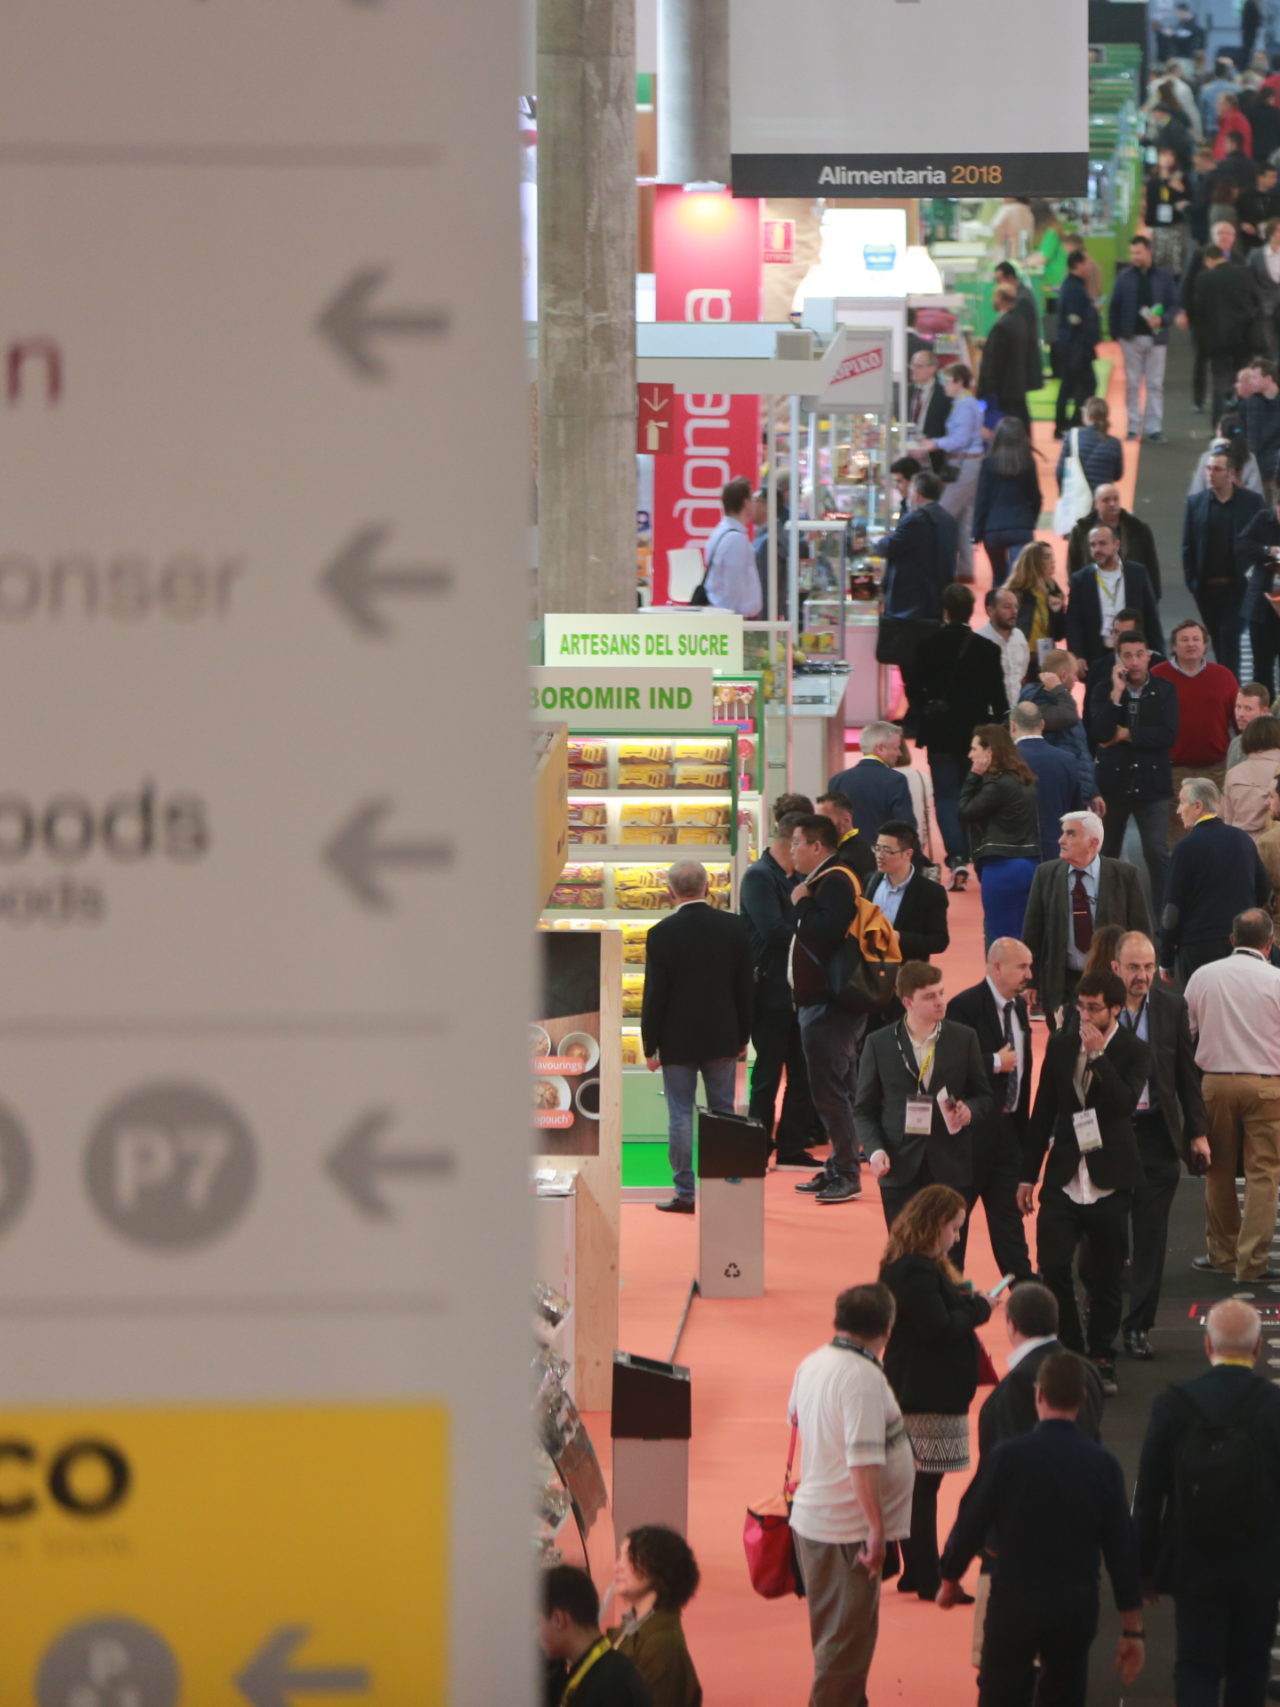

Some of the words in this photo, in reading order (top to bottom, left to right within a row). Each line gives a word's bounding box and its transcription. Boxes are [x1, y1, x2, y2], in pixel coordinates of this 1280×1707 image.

[818, 165, 947, 185] Alimentaria
[951, 165, 1002, 184] 2018
[559, 634, 640, 656] ARTESANS
[645, 634, 673, 655] DEL
[678, 634, 729, 656] SUCRE
[650, 687, 693, 709] IND
